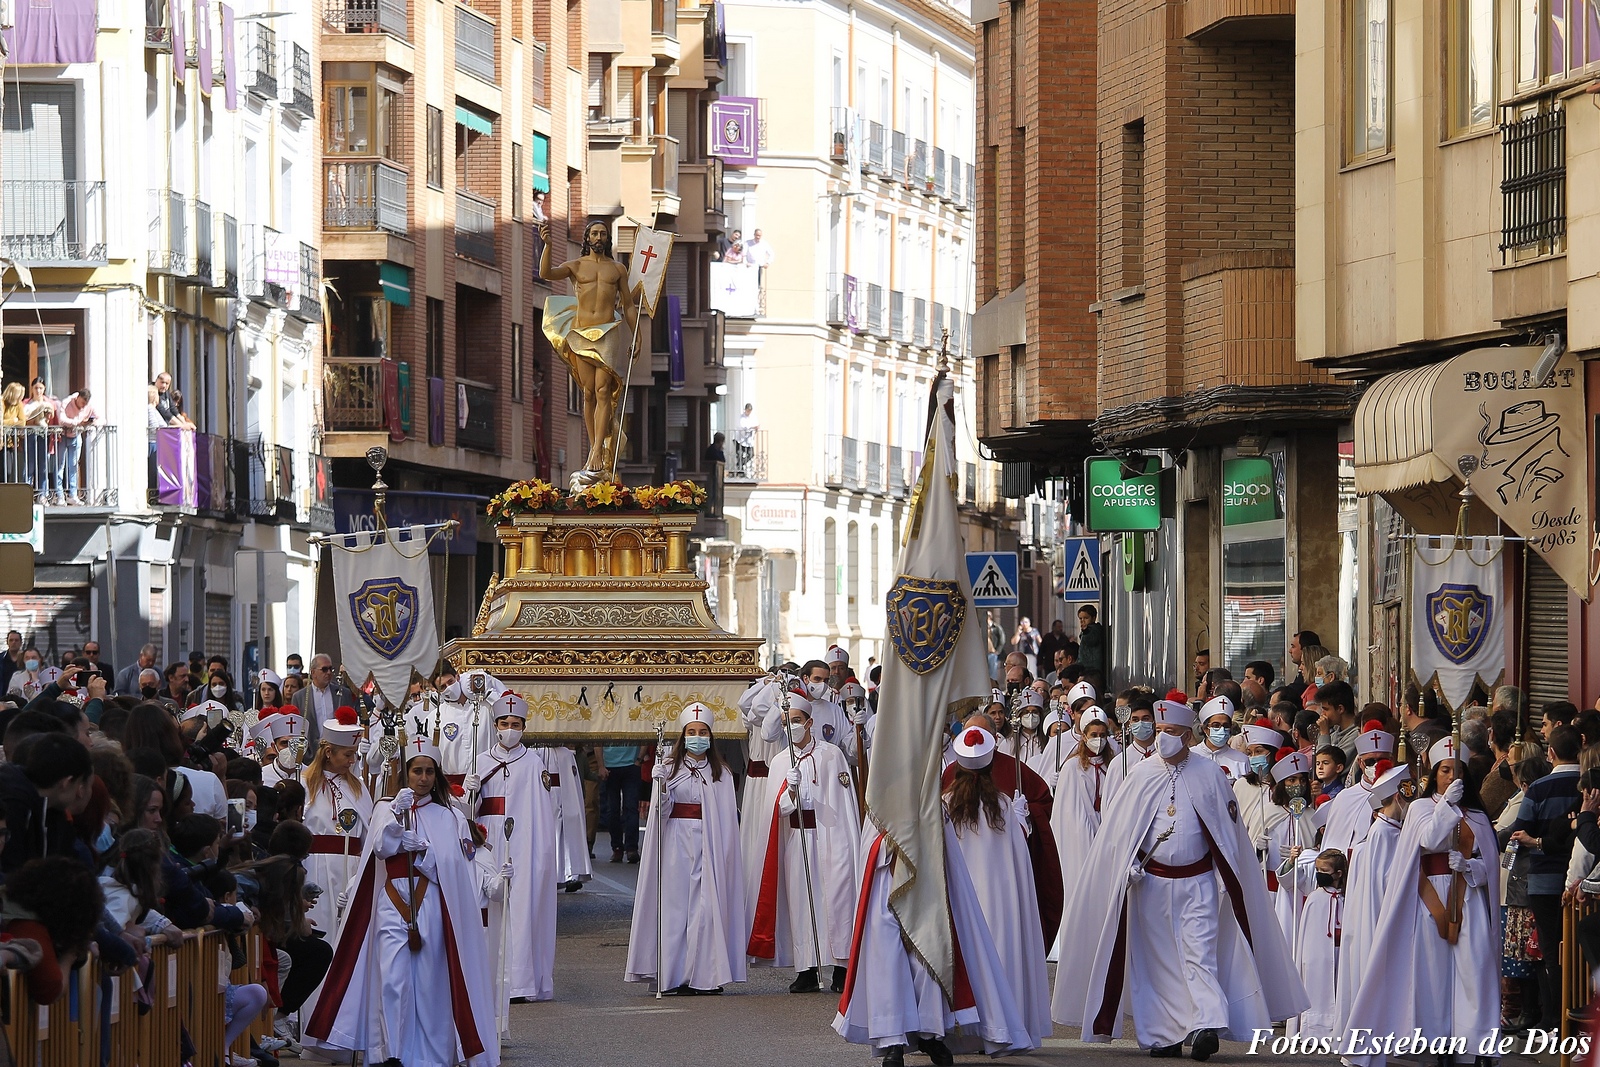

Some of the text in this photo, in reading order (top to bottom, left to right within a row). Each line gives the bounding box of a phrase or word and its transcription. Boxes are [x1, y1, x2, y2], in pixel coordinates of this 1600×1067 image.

[267, 249, 298, 262] VENDE
[1092, 481, 1156, 497] codere
[1103, 498, 1156, 507] APUESTAS
[349, 514, 375, 533] MGS
[1531, 506, 1582, 530] Desde
[1540, 528, 1577, 553] 1985
